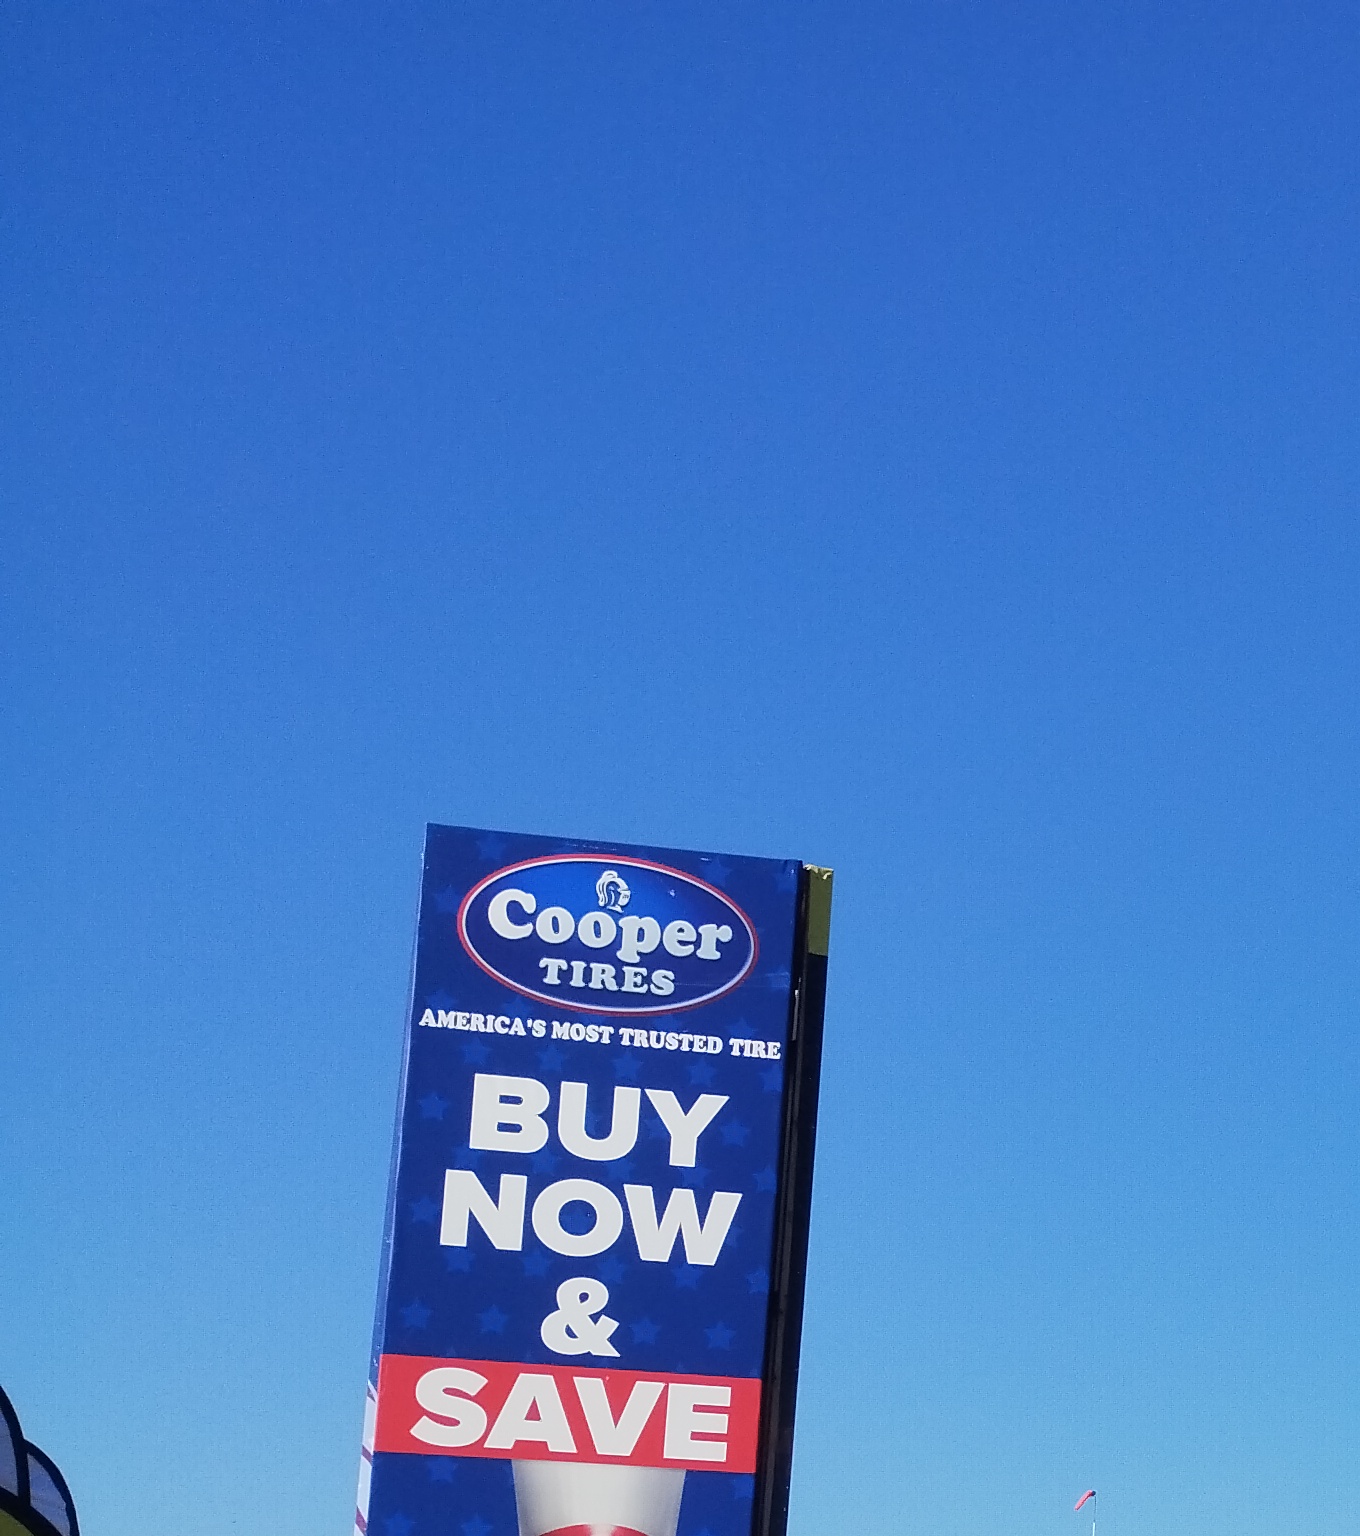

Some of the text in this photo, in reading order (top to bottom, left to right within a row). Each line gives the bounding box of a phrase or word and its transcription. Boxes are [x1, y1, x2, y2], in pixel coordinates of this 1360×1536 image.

[487, 889, 732, 962] Cooper
[538, 957, 676, 997] TIRES
[418, 1008, 781, 1060] AMERICA'S MOST TRUSTED TIRE
[469, 1072, 729, 1168] BUY
[439, 1168, 742, 1266] NOW
[540, 1277, 620, 1358] &
[409, 1366, 732, 1462] SAVE
